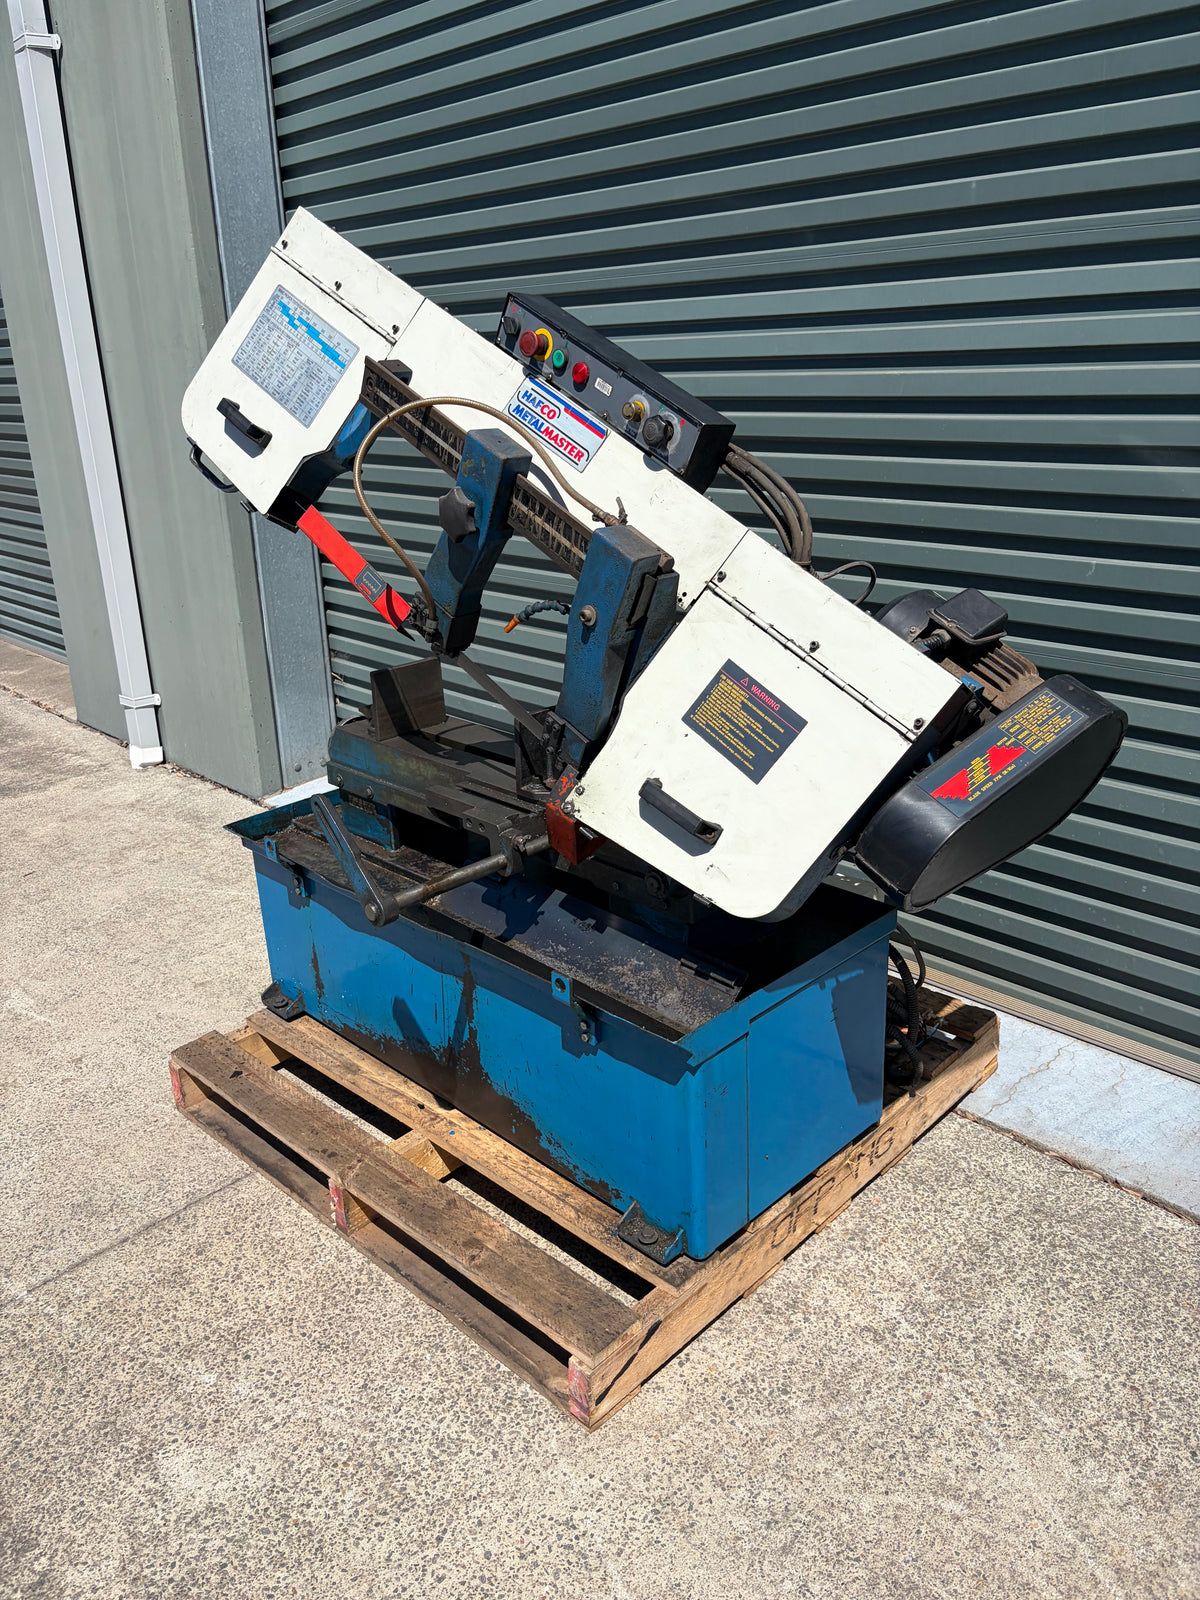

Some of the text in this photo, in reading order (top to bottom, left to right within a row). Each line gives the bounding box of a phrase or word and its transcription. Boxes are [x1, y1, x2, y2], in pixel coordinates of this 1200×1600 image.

[521, 390, 557, 420] HAFCO
[512, 404, 585, 462] METALMASTER
[750, 684, 781, 712] WARNING
